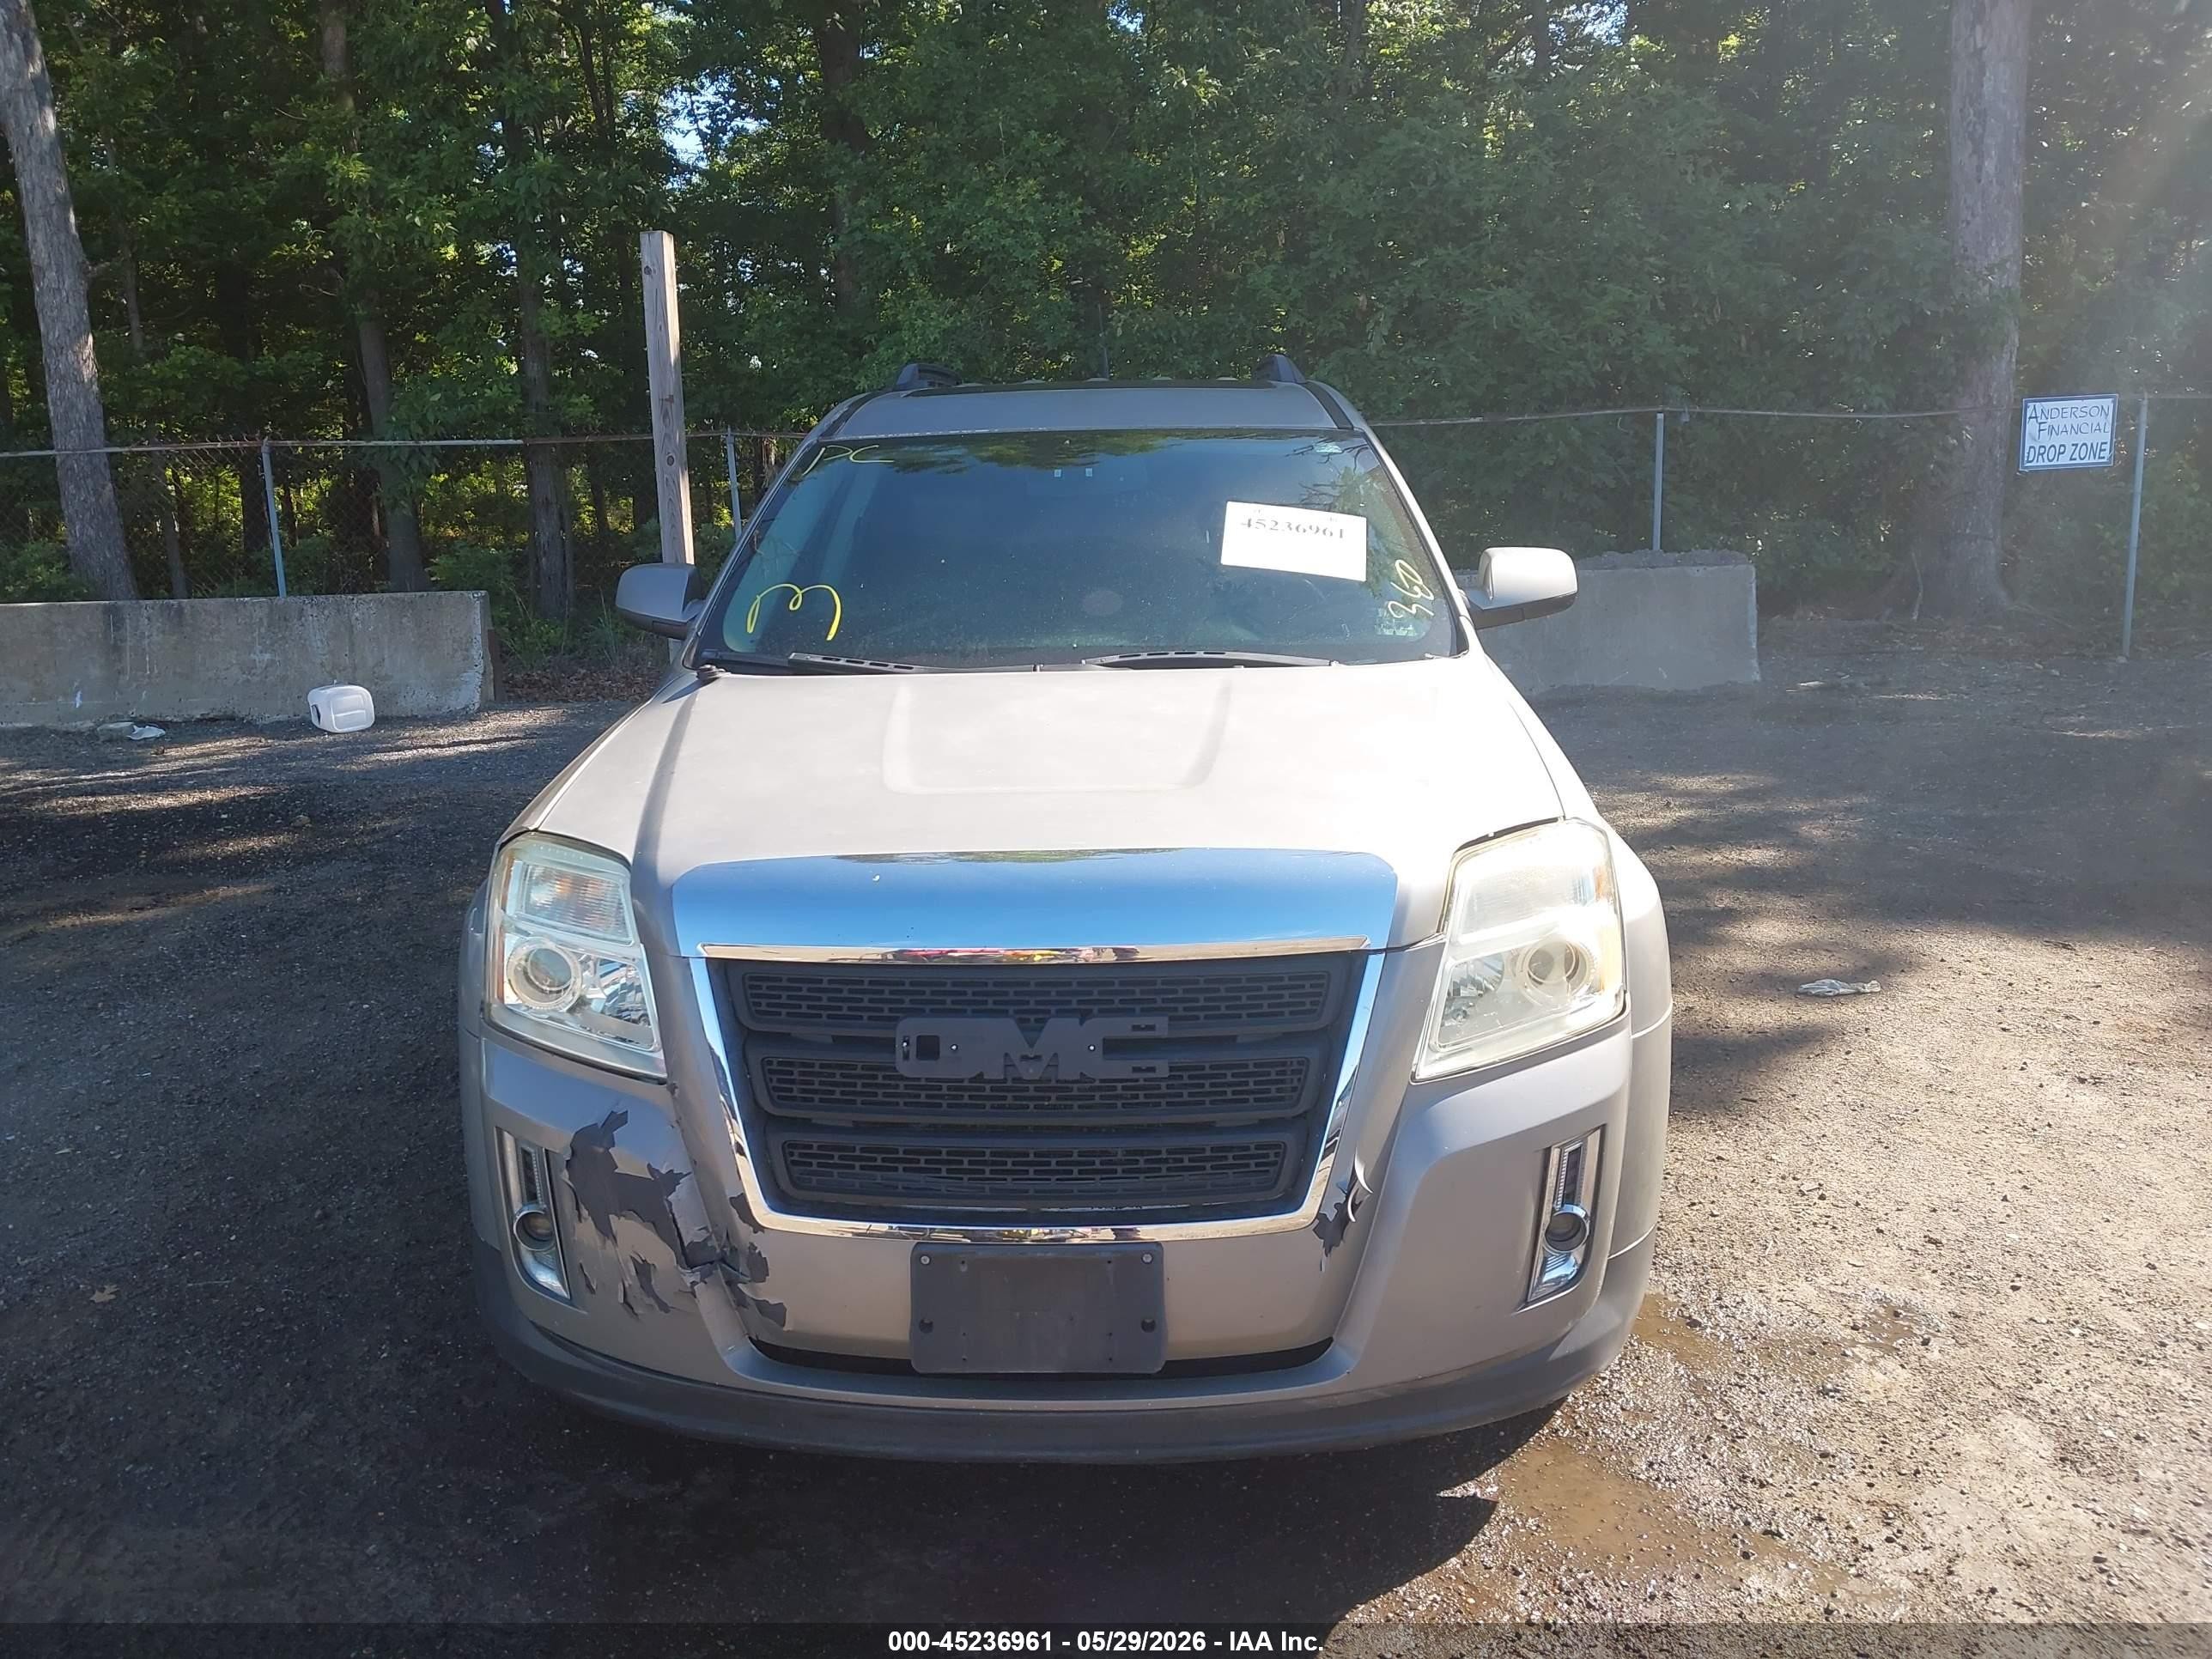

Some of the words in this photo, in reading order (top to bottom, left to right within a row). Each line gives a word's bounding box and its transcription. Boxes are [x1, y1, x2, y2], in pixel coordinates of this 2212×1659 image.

[2027, 404, 2110, 423] ANDERSON
[2038, 422, 2110, 440] FINANCIAL
[2027, 444, 2066, 463] DROP
[2069, 441, 2108, 460] ZONE
[1241, 516, 1345, 539] 45236961
